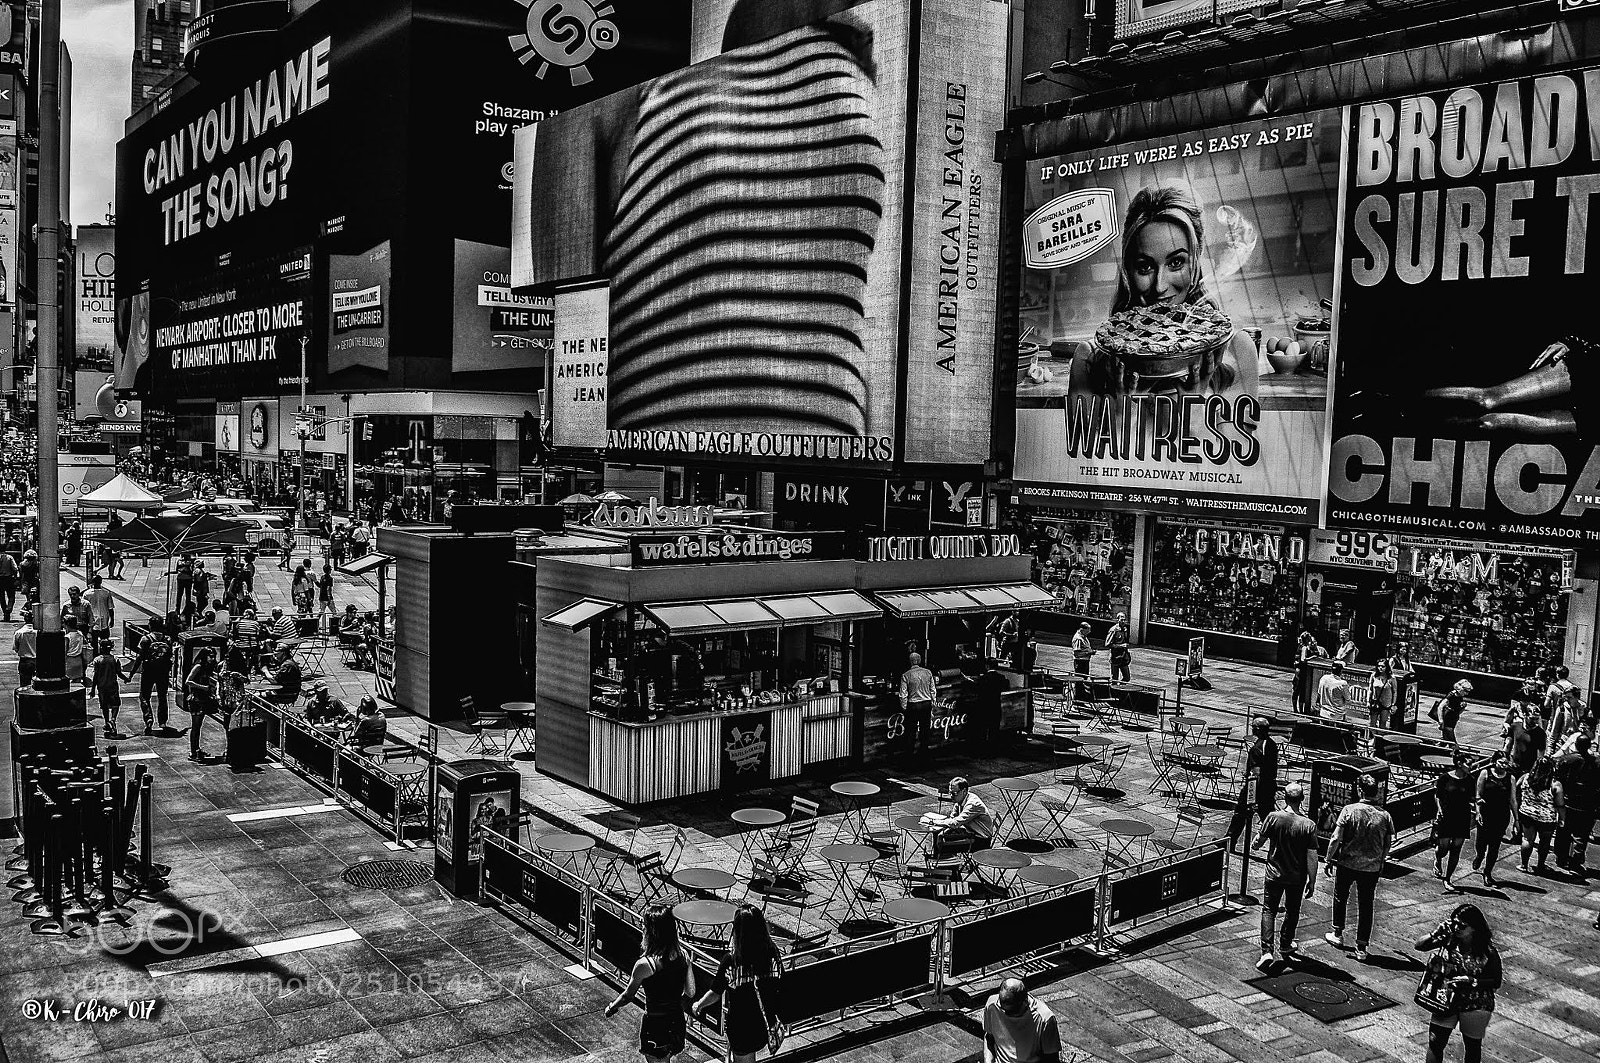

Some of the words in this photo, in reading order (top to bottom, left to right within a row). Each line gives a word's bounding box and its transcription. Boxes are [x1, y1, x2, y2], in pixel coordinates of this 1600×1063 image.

[144, 130, 184, 195] CAN
[189, 96, 236, 171] YOU
[243, 35, 331, 144] NAME
[483, 102, 544, 121] Shazam
[475, 119, 508, 137] play
[943, 82, 967, 189] EAGLE
[1041, 167, 1055, 180] IF
[1057, 158, 1095, 177] ONLY
[1099, 154, 1129, 170] LIFE
[1134, 145, 1176, 165] WERE
[1182, 141, 1203, 157] AS
[1208, 133, 1251, 153] EASY
[1256, 129, 1279, 145] AS
[1285, 123, 1314, 142] PIE
[161, 183, 201, 246] THE
[206, 140, 293, 229] SONG?
[1038, 209, 1066, 225] ORIGINAL
[1066, 202, 1086, 214] MUSIC
[1087, 198, 1096, 207] BY
[1051, 213, 1084, 232] SARA
[966, 172, 982, 291] OUTFITTERS
[1037, 220, 1102, 252] BAREILLES
[1351, 180, 1535, 287] SURE
[1070, 241, 1081, 250] AND
[280, 260, 303, 273] UNITED
[483, 271, 511, 284] COM
[484, 290, 511, 303] TELL
[512, 293, 527, 304] US
[936, 196, 962, 376] AMERICAN
[335, 297, 345, 308] TELL
[156, 324, 186, 348] NEWARK
[186, 316, 221, 343] AIRPORT:
[222, 310, 255, 337] CLOSER
[257, 308, 270, 332] TO
[272, 301, 303, 330] MORE
[337, 314, 348, 329] THE
[348, 309, 381, 326] UN-CARRIER
[500, 311, 529, 326] THE
[171, 349, 182, 370] OF
[182, 341, 230, 369] MANHATTAN
[231, 338, 257, 363] THAN
[258, 335, 277, 361] JFK
[562, 340, 585, 354] THE
[557, 362, 608, 378] AMERIC
[1063, 393, 1261, 467] WAITRESS
[607, 430, 690, 451] AMERICAN
[698, 432, 752, 455] EAGLE
[757, 434, 894, 462] OUTFITTERS
[1080, 466, 1099, 476] THE
[1102, 467, 1120, 477] HIT
[1123, 468, 1185, 480] BROADWAY
[1189, 471, 1243, 484] MUSICAL
[785, 482, 849, 506] DRINK
[1023, 487, 1051, 497] BROOKS
[1051, 489, 1089, 499] ATKINSON
[1089, 491, 1124, 502] THEATRE
[1128, 494, 1142, 502] 256
[1168, 497, 1179, 506] ST.
[1185, 498, 1307, 515] WAITRESSTHEMUSICAL.COM
[1574, 494, 1600, 504] THE
[1332, 510, 1486, 531] CHICAGOTHEMUSICAL.COM
[639, 534, 813, 560] wafels&dinges
[930, 535, 988, 559] QUINN'S
[991, 534, 1021, 557] BBQ
[1195, 528, 1304, 564] GRAND
[1385, 545, 1501, 586] SLAM
[1329, 555, 1343, 563] NYC
[1344, 557, 1374, 567] SOUVENIR
[1320, 783, 1352, 799] SURE
